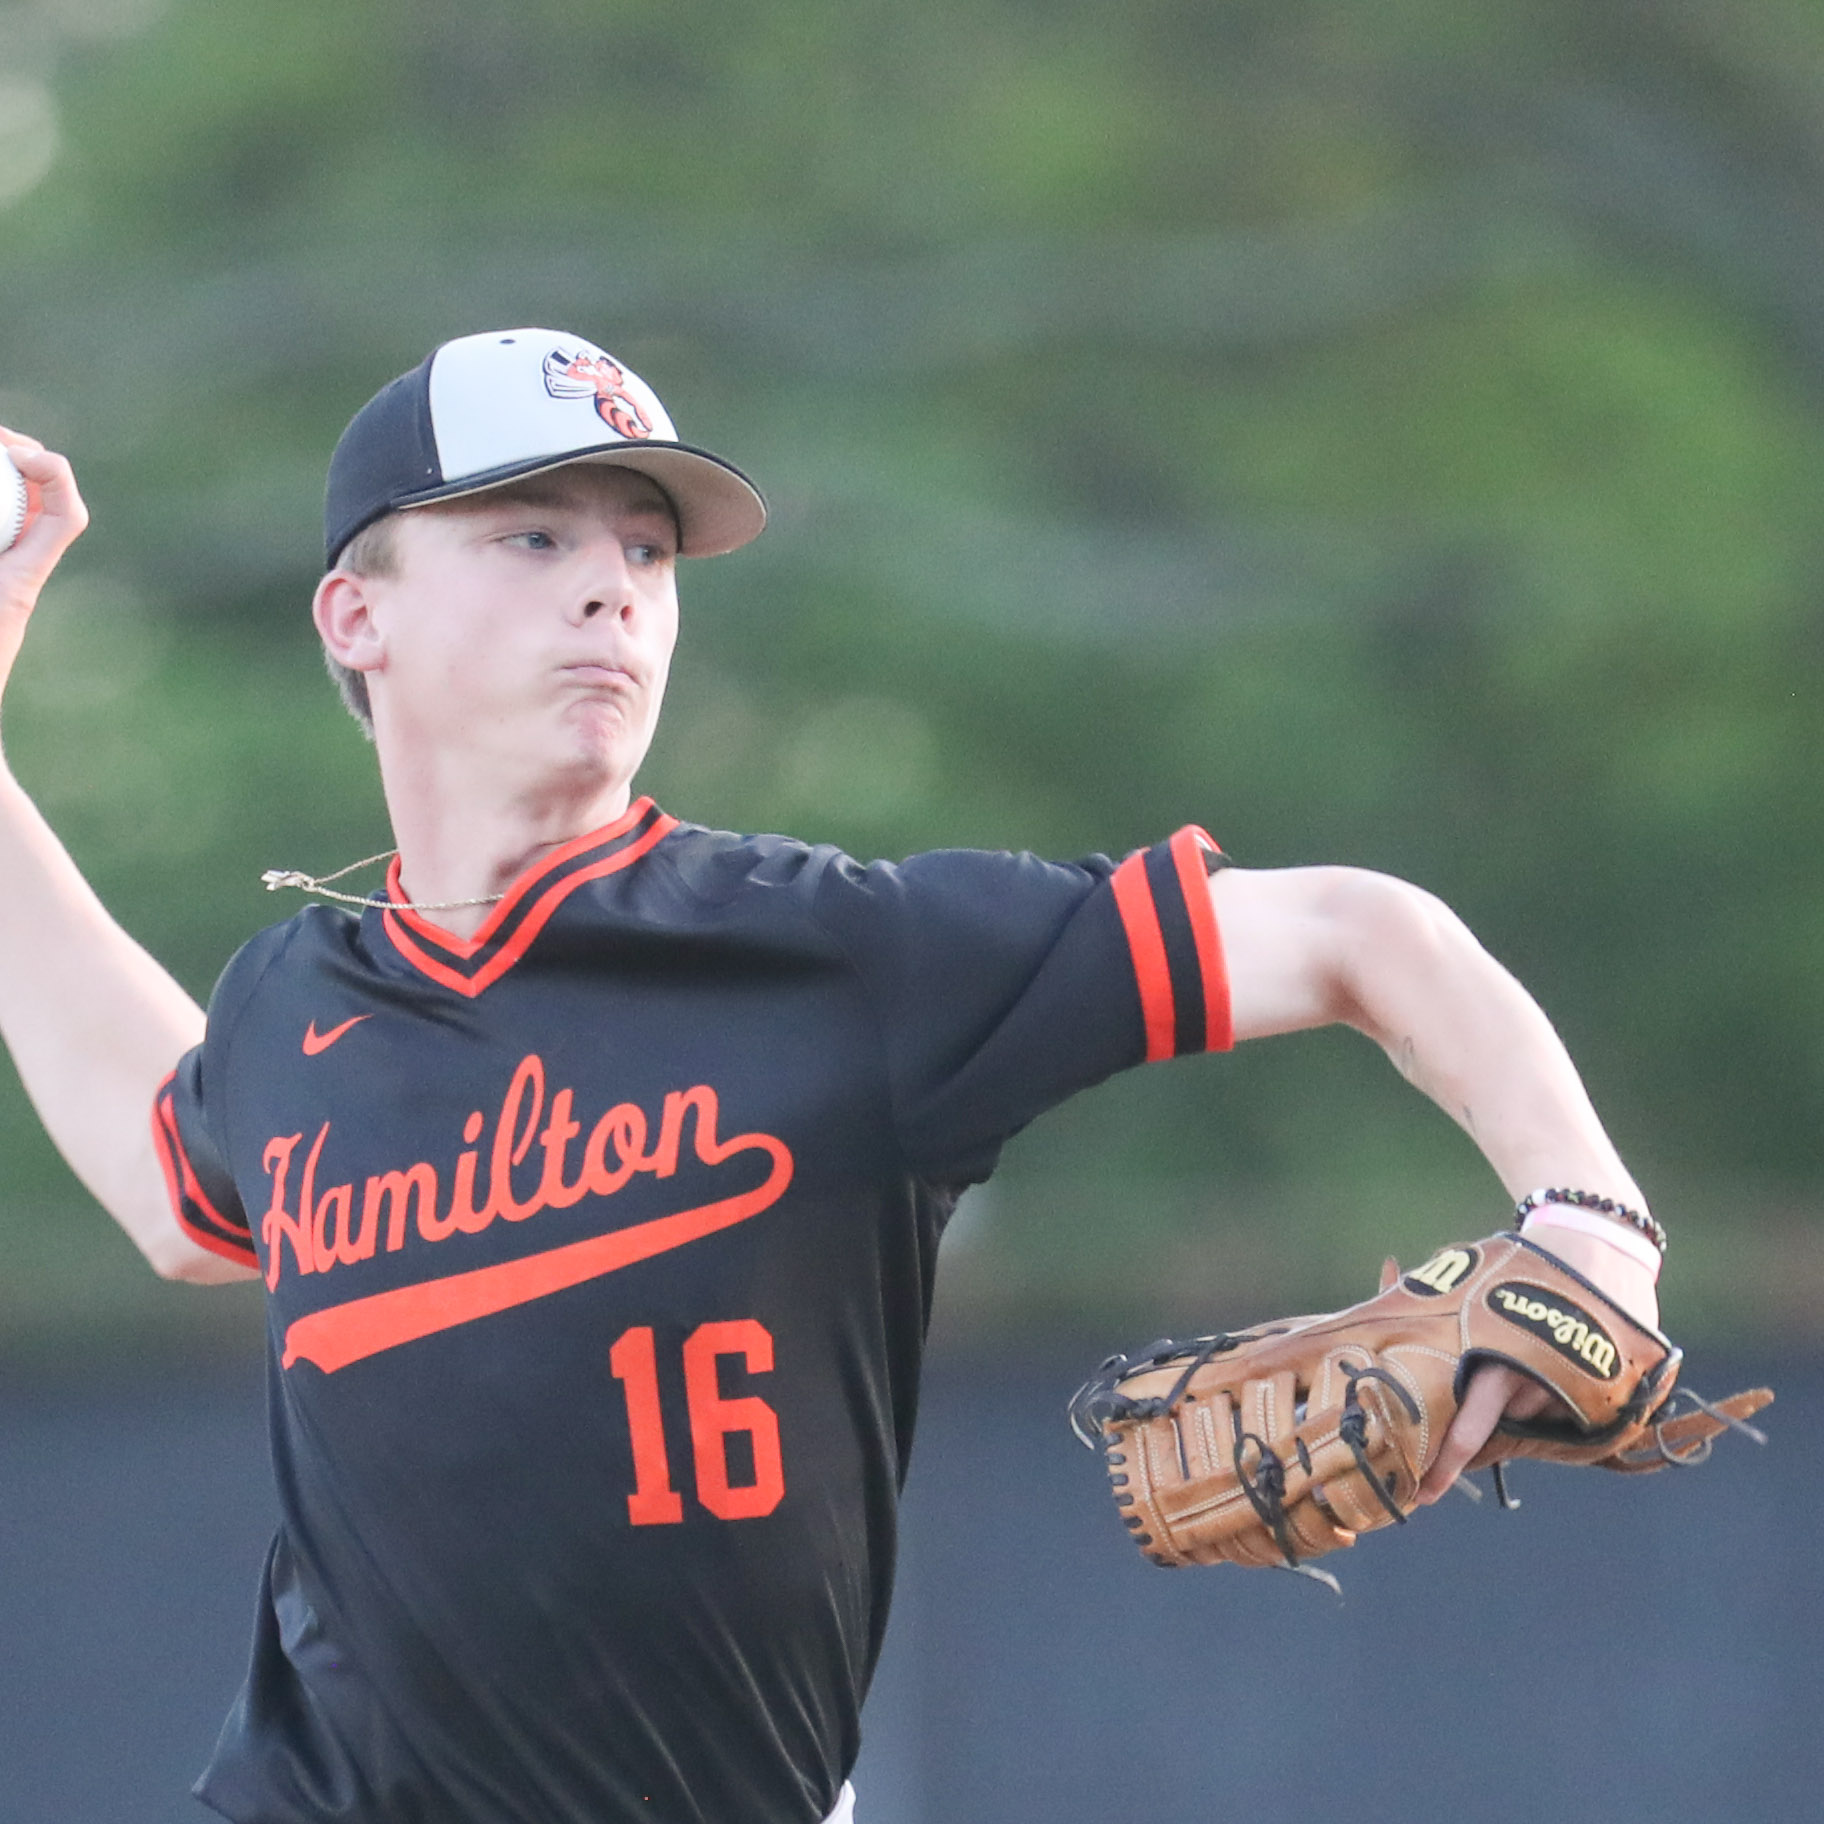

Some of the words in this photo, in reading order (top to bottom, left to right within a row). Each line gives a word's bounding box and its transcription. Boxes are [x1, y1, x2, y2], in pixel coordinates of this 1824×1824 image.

[262, 1054, 746, 1293] Hamilton
[609, 1318, 785, 1526] 16
[1497, 1289, 1616, 1379] Wilson
